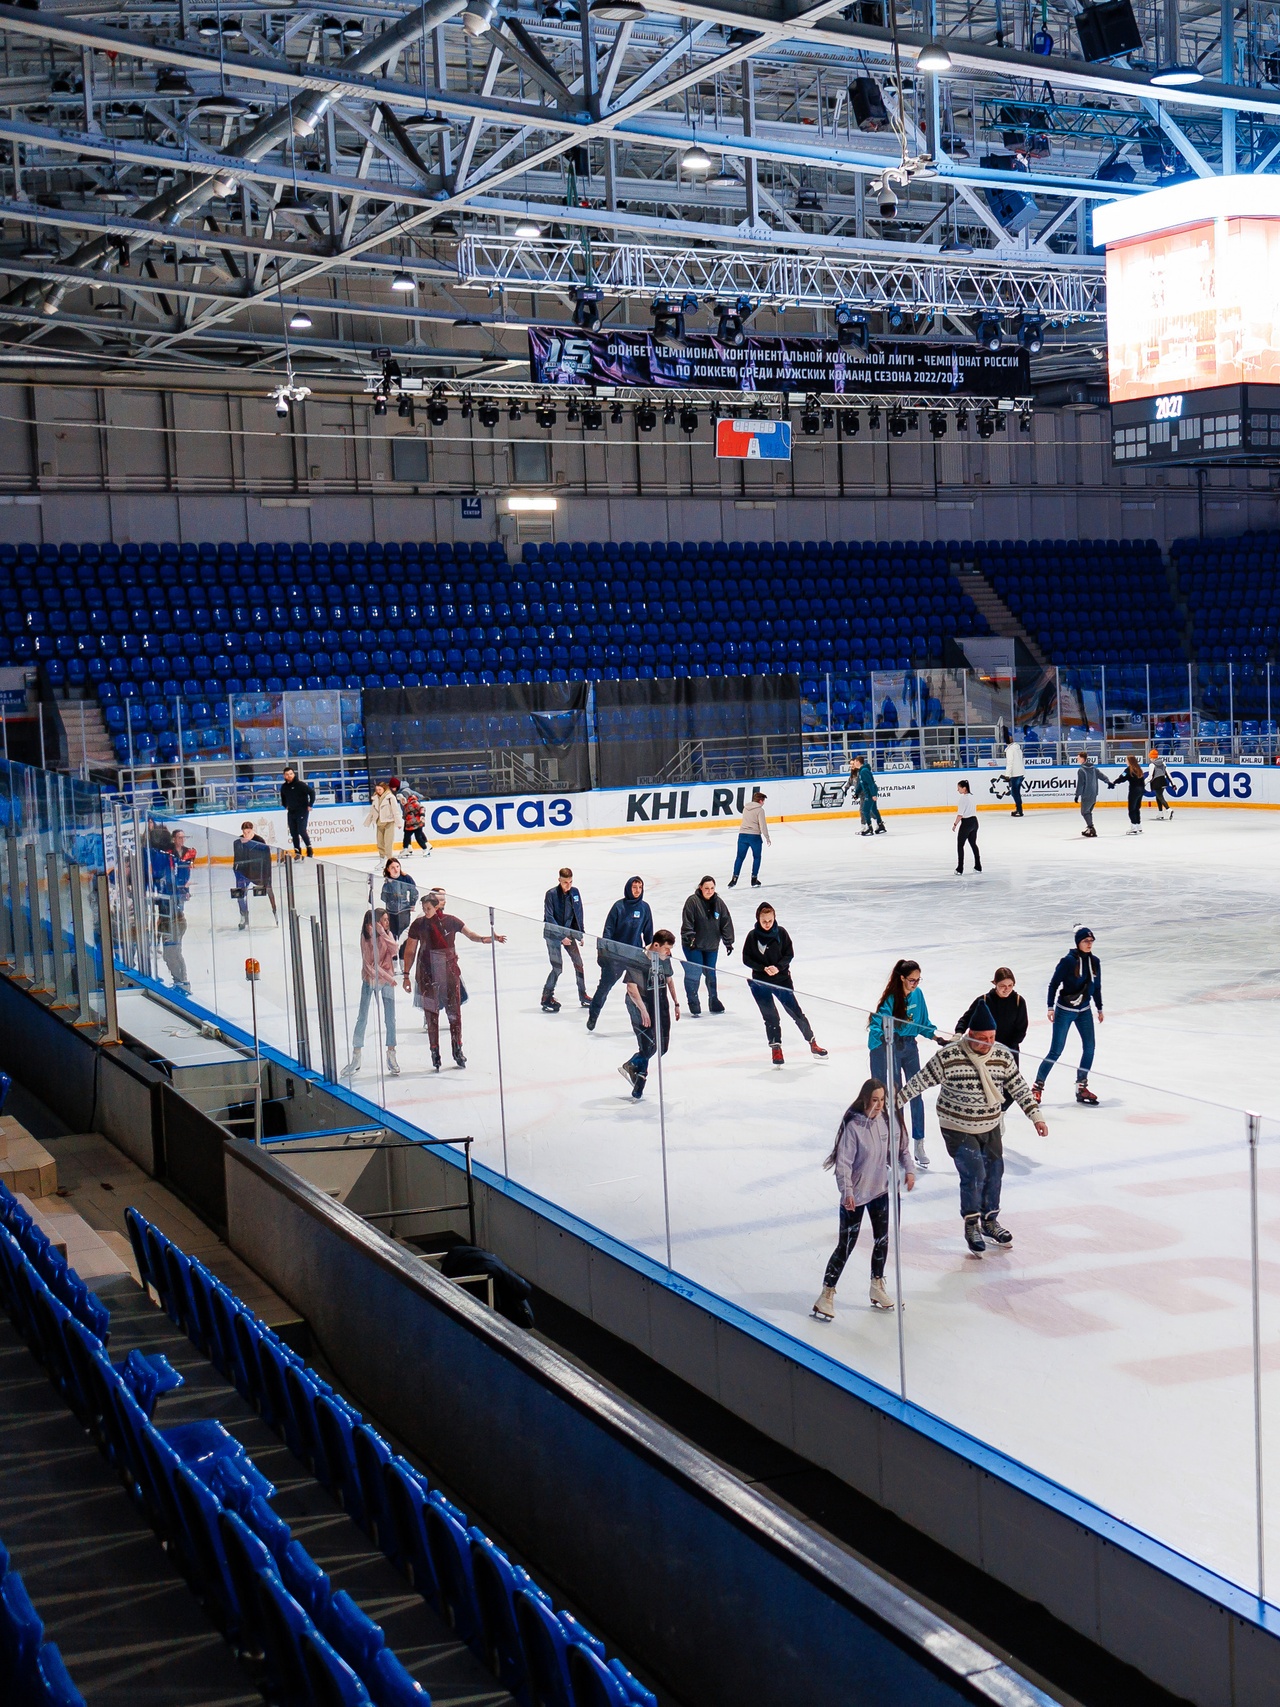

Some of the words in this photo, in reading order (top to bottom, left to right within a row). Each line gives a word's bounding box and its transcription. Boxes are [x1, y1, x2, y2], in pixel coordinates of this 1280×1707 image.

[607, 343, 650, 358] ФОНБЕТ
[655, 346, 719, 360] ЧЕМПИОНАТ
[723, 347, 822, 364] КОНТИНЕНТАЛЬНОЙ
[887, 354, 915, 366] ЛИГИ
[924, 354, 981, 368] ЧЕМПИОНАТ
[984, 356, 1019, 368] РОССИИ
[675, 364, 690, 377] ПО
[693, 364, 736, 378] ХОККЕЮ
[739, 366, 771, 380] СРЕДИ
[776, 368, 826, 381] МУЖСКИХ
[828, 370, 873, 383] КОМАНД
[874, 371, 912, 383] СЕЗОНА
[913, 371, 965, 384] 2022/2023
[1155, 395, 1183, 419] 20:27
[886, 763, 911, 771] LADA
[1200, 756, 1224, 764] KHL.RU
[1240, 756, 1263, 764] KHL.RU
[626, 786, 761, 823] KHL.RU
[431, 798, 573, 835] согаз
